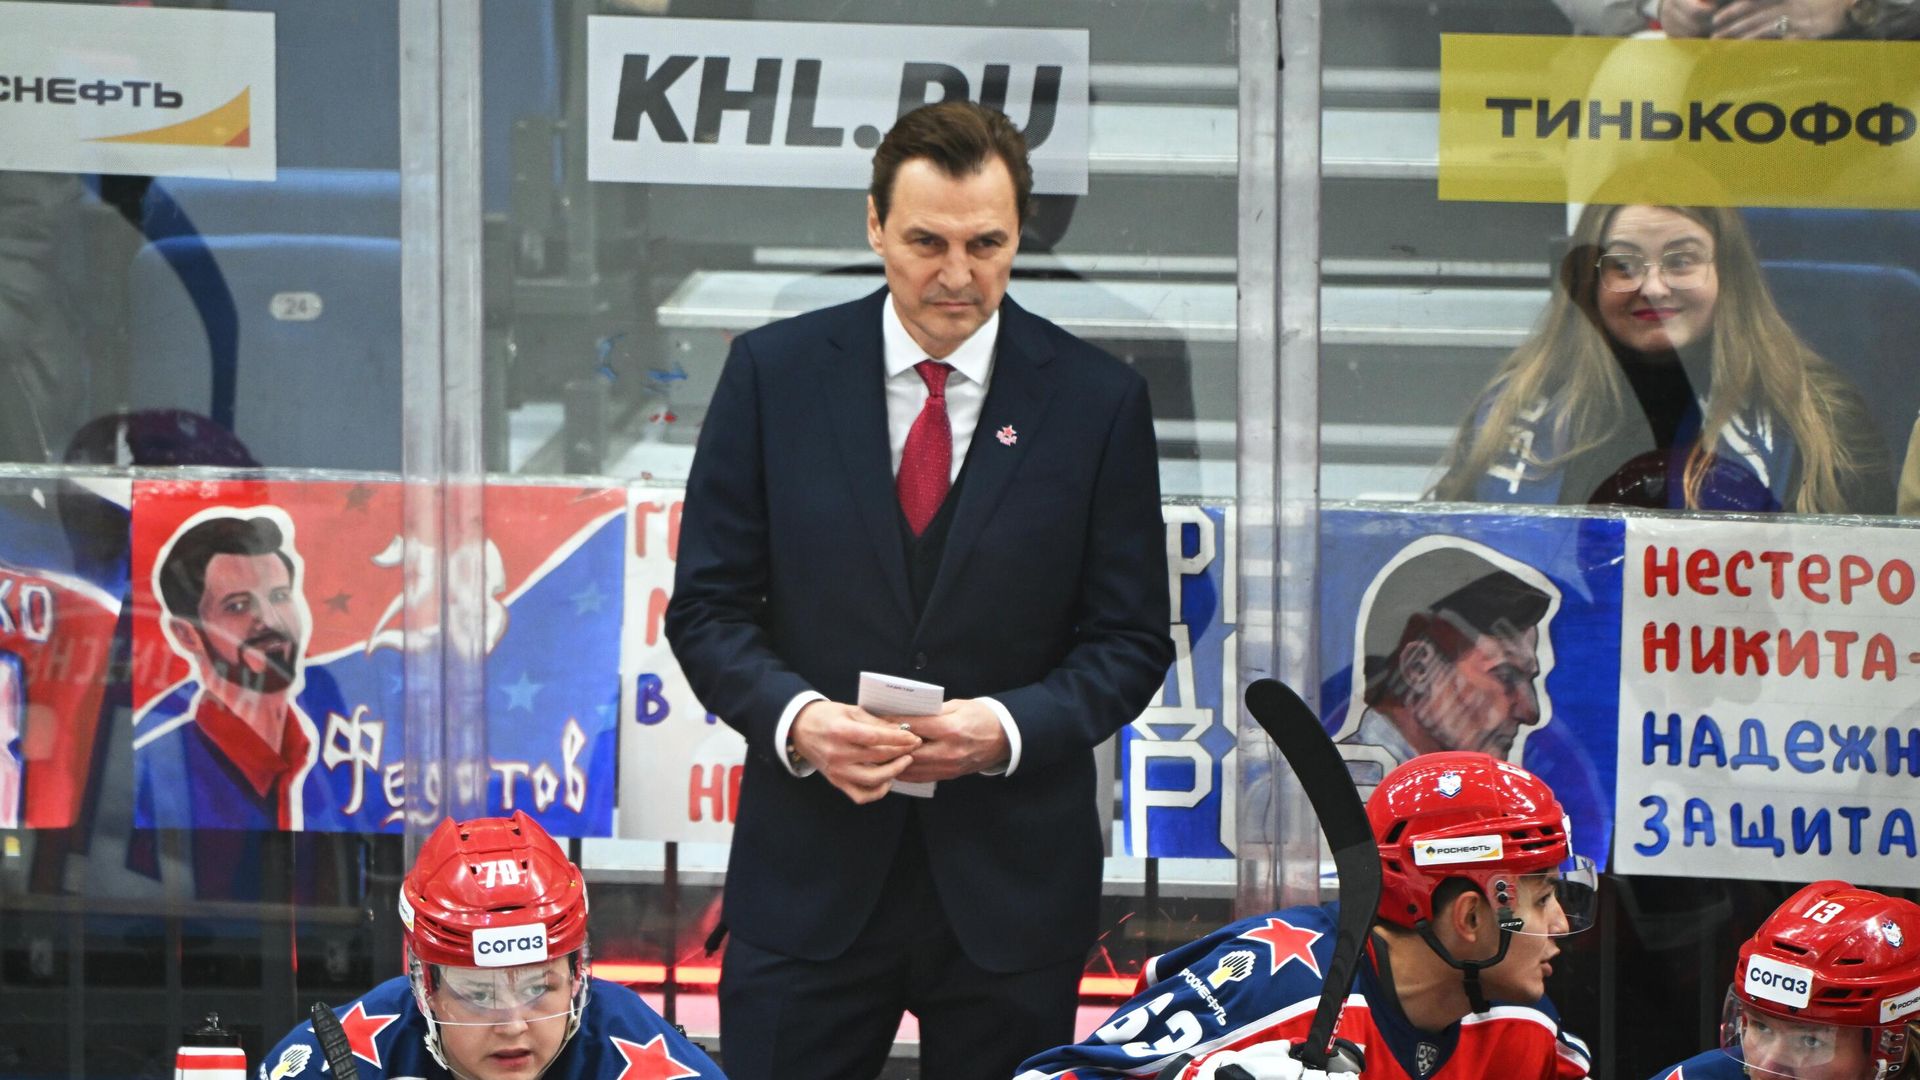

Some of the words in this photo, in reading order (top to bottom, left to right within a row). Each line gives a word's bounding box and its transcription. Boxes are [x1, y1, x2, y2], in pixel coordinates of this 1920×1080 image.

[1485, 97, 1917, 146] ТИНЬКОФФ
[1437, 844, 1491, 855] РОСНЕФТЬ
[482, 860, 520, 889] 70
[1802, 900, 1845, 924] 13
[1095, 992, 1203, 1058] 63
